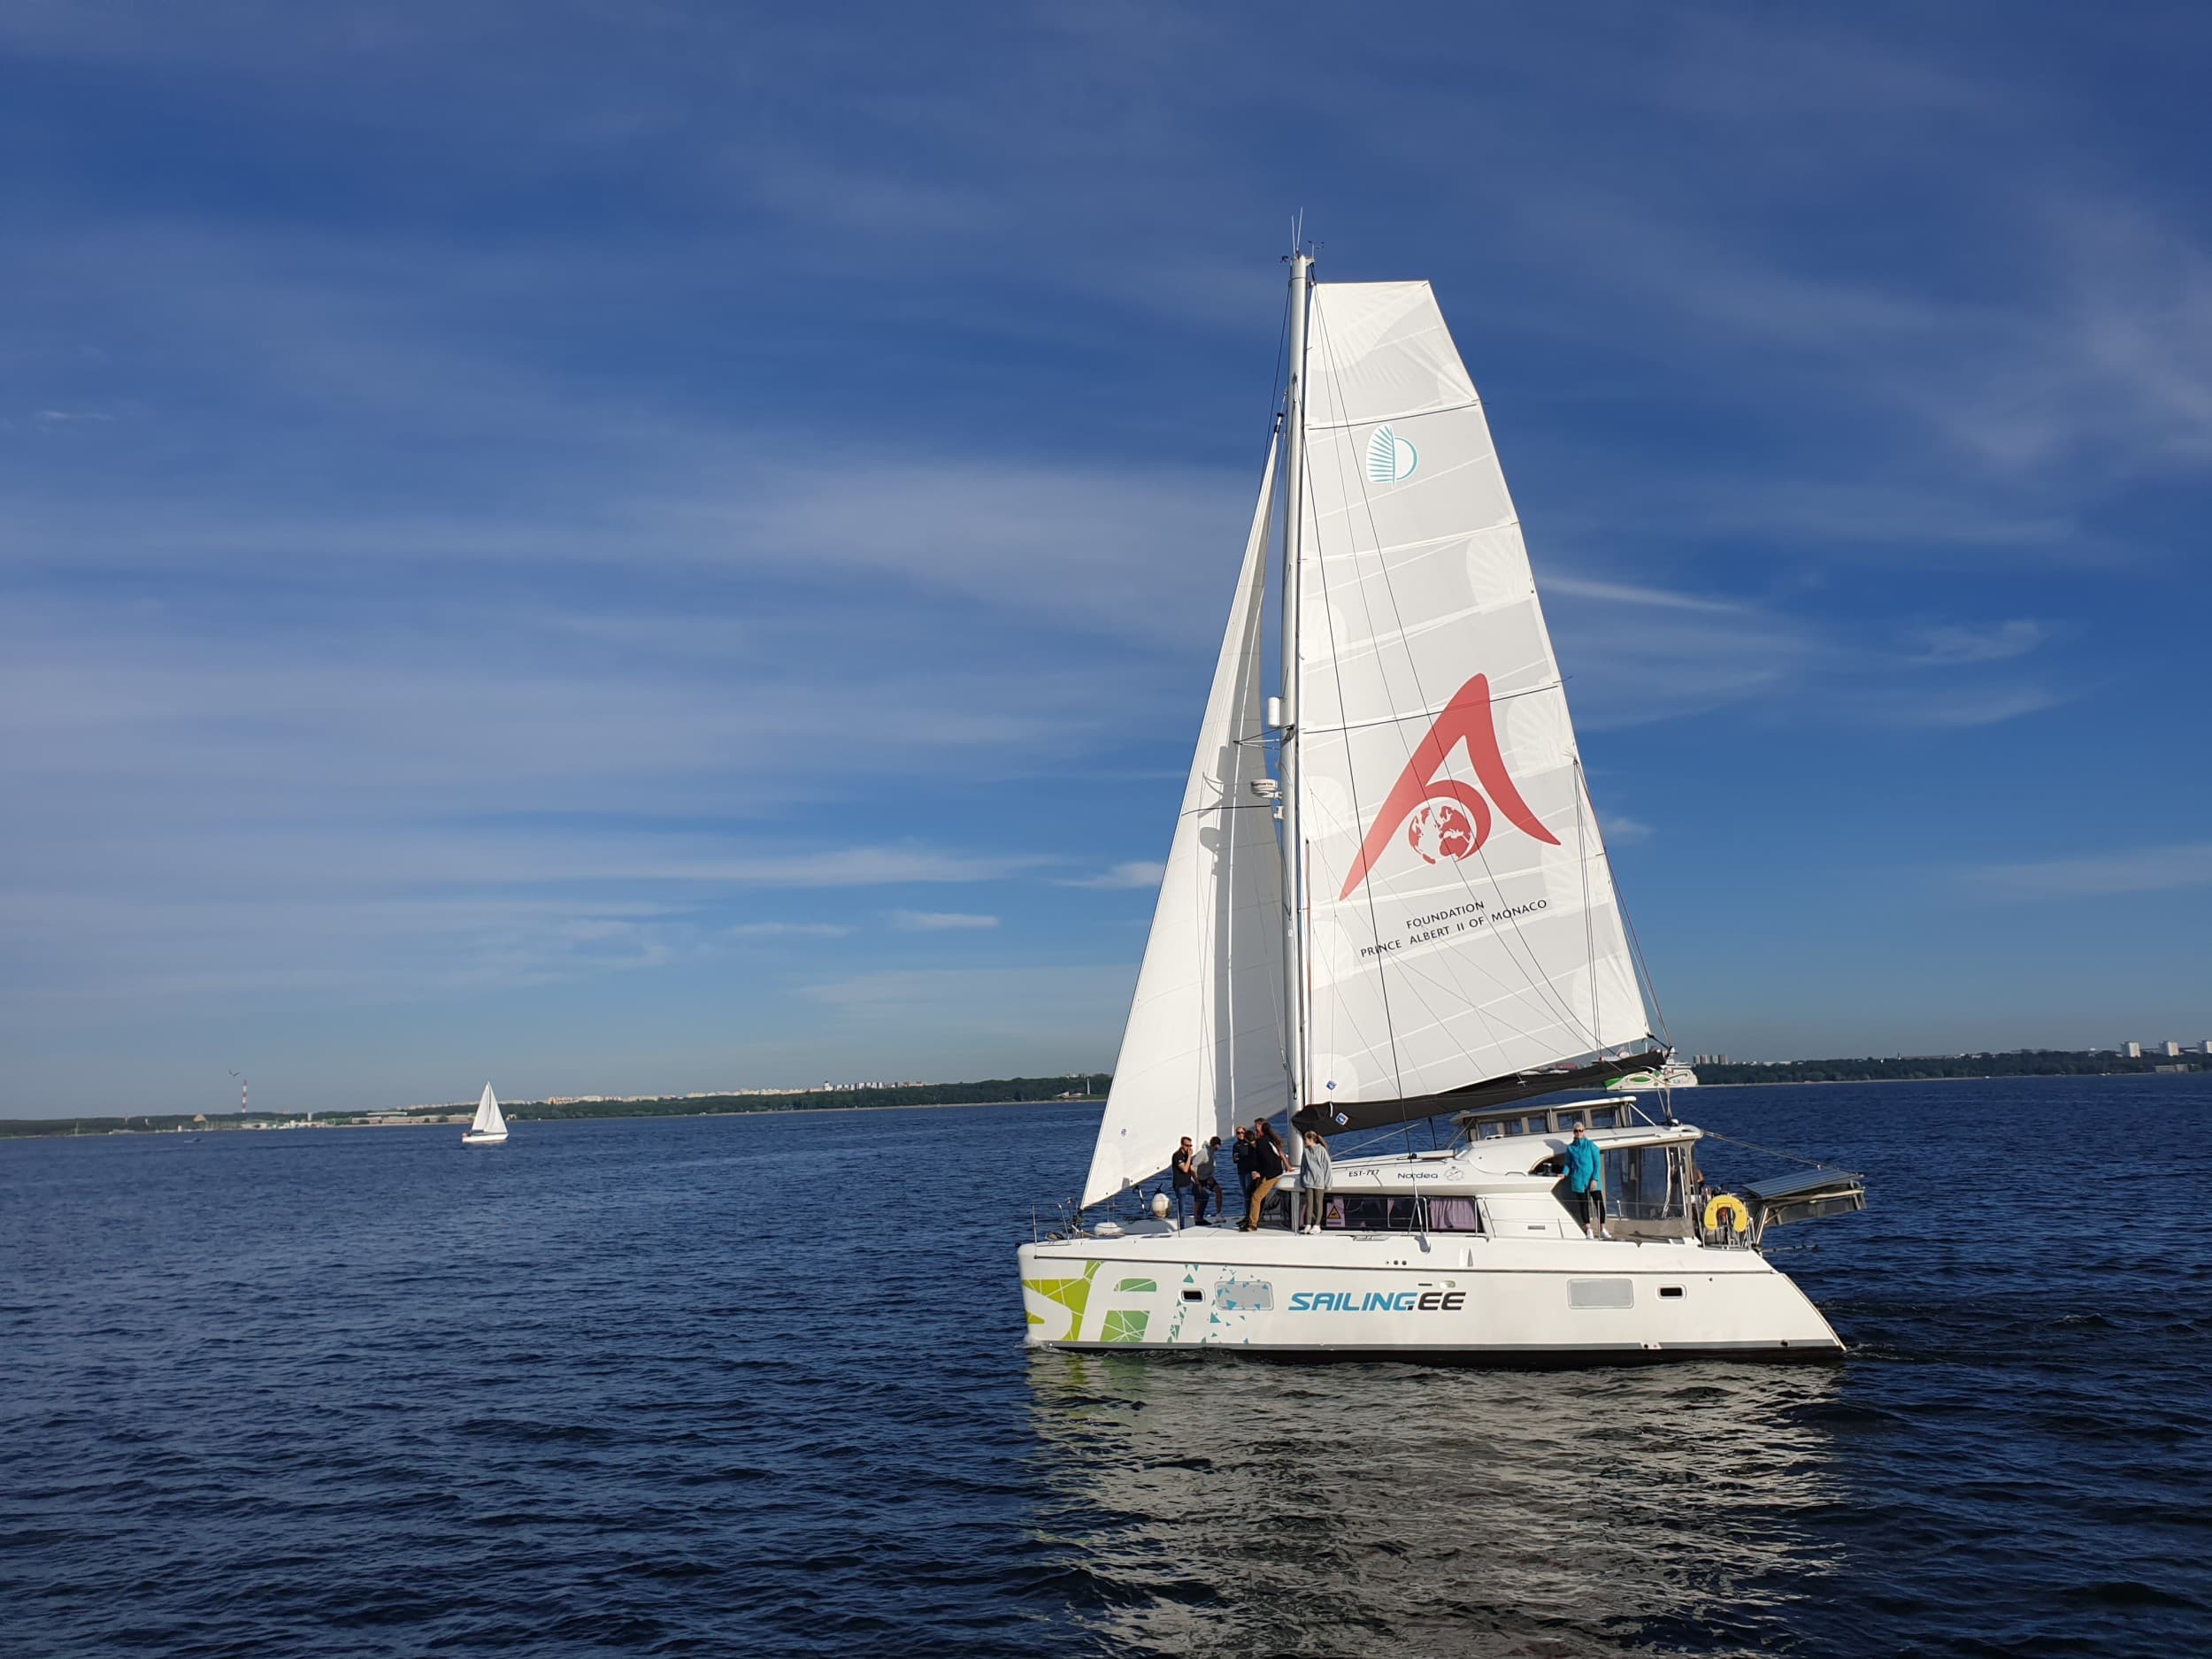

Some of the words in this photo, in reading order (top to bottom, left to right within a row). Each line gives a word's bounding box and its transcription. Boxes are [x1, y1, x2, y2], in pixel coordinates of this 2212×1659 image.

[1360, 939, 1402, 957] PRINCE
[1409, 926, 1450, 945] ALBERT
[1469, 916, 1485, 928] OF
[1491, 899, 1548, 922] MONACO
[1406, 901, 1485, 930] FOUNDATION
